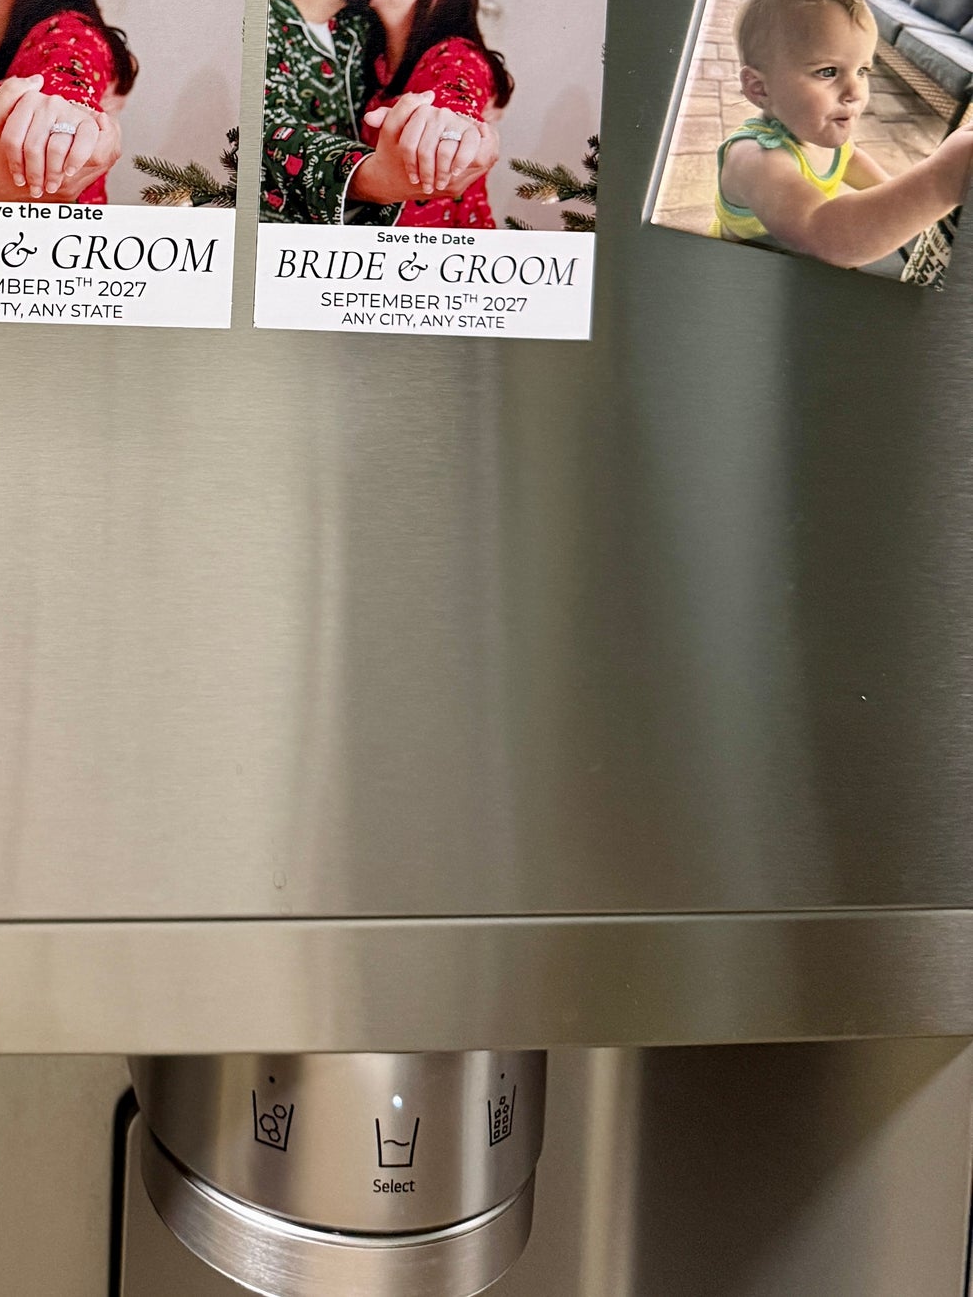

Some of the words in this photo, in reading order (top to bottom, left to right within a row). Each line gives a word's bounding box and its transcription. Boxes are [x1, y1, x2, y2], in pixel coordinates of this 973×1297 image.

[18, 202, 52, 219] the
[58, 203, 104, 220] Date
[376, 231, 410, 244] Save
[413, 232, 438, 245] the
[441, 233, 476, 246] Date
[0, 231, 38, 268] &
[51, 234, 219, 273] GROOM
[274, 249, 387, 281] BRIDE
[397, 251, 429, 282] &
[439, 253, 578, 286] GROOM
[55, 276, 93, 296] 15TH
[97, 280, 147, 298] 2027
[320, 291, 440, 310] SEPTEMBER
[444, 293, 478, 311] 15TH
[482, 296, 528, 312] 2027
[28, 303, 67, 318] ANY
[70, 303, 124, 319] STATE
[341, 312, 376, 325] ANY
[379, 312, 416, 328] CITY,
[419, 314, 455, 327] ANY
[457, 315, 505, 329] STATE
[372, 1177, 416, 1193] Select
